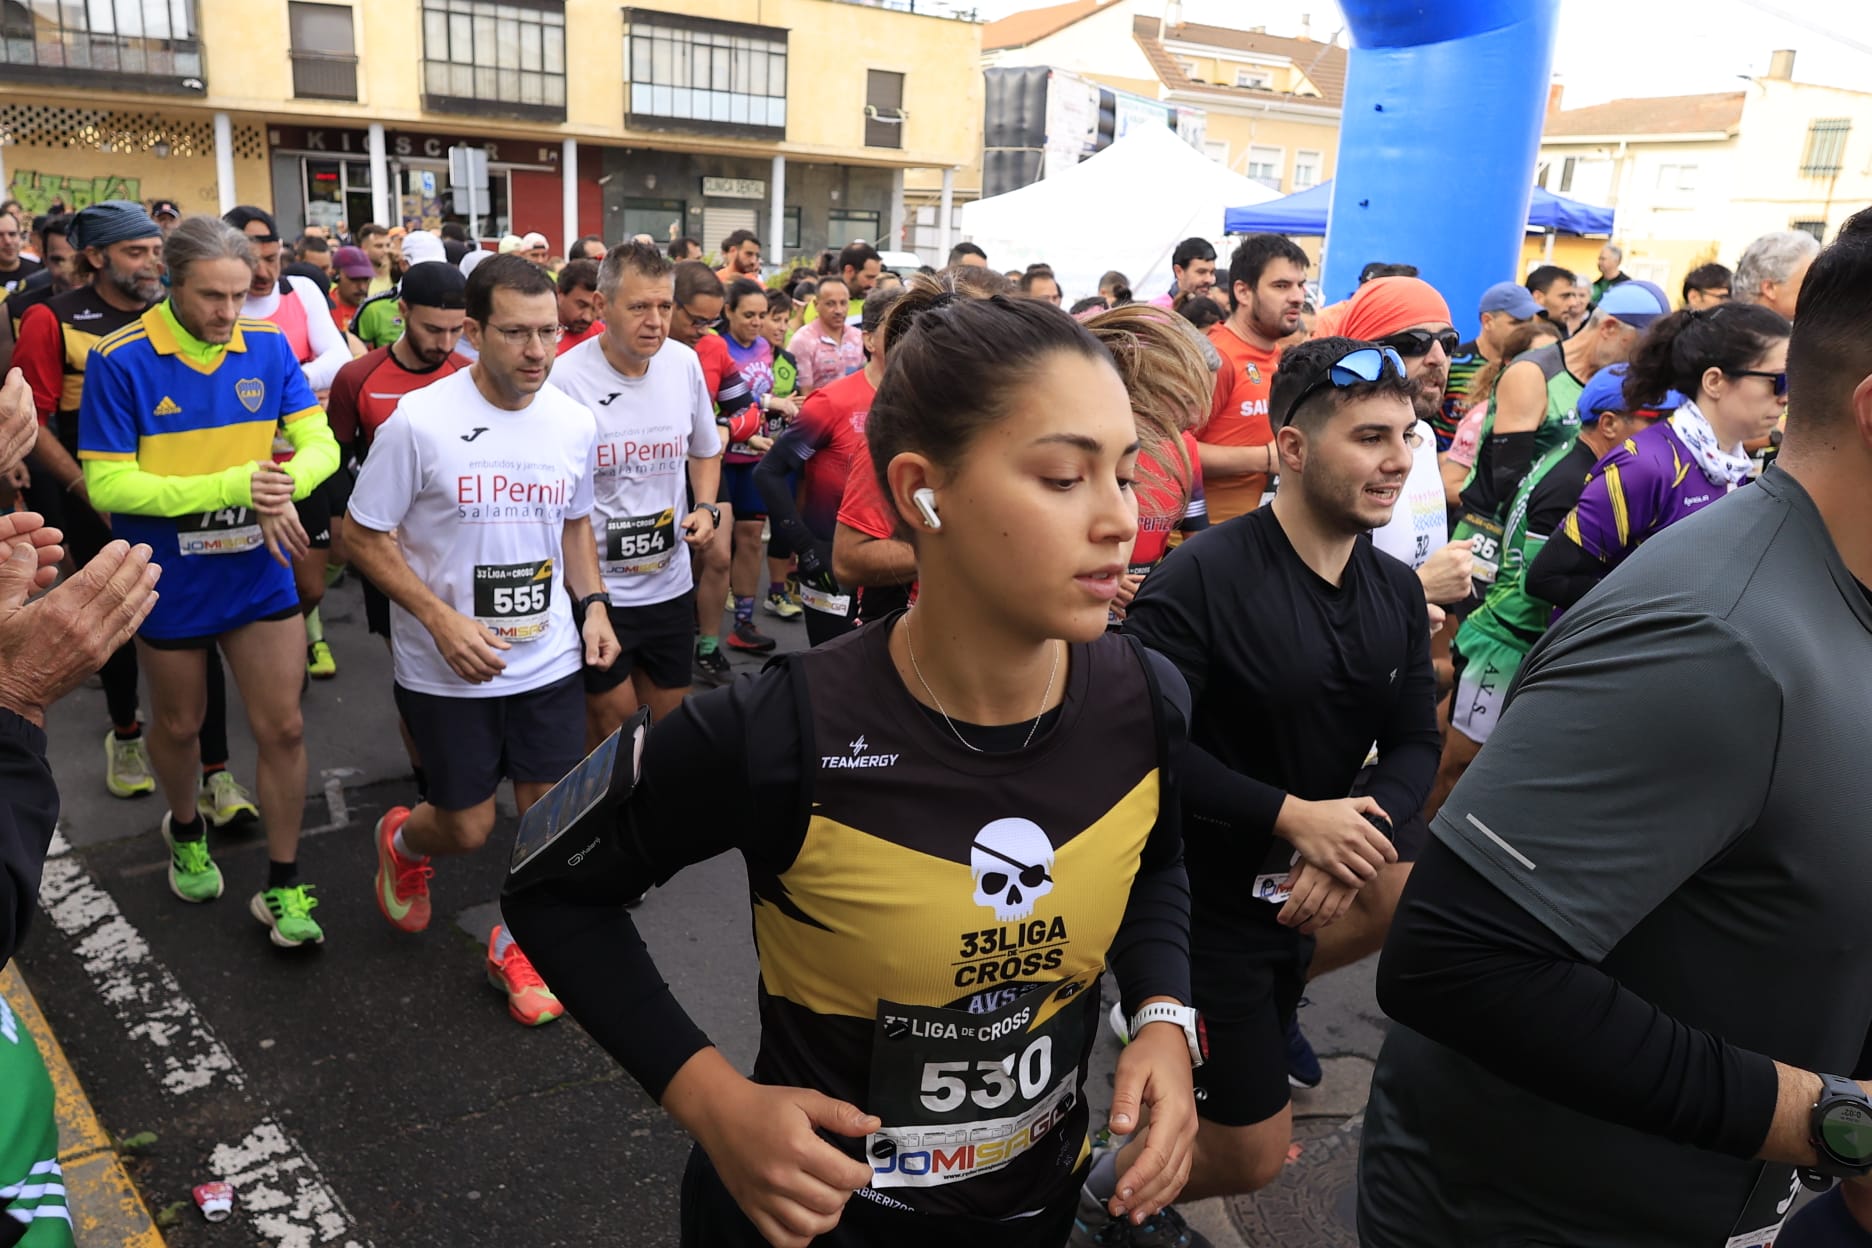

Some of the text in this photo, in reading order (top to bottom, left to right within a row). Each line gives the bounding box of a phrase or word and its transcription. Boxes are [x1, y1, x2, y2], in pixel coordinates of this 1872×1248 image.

[597, 435, 683, 467] El Pernil
[457, 474, 565, 505] El Pernil
[621, 530, 664, 557] 554
[488, 567, 506, 579] LIGA
[493, 583, 545, 614] 555
[821, 754, 899, 769] TEAMERGY
[954, 948, 1064, 988] CROSS
[968, 986, 1017, 1014] AVS
[911, 1018, 958, 1040] LIGA
[961, 1027, 975, 1037] DE
[977, 1006, 1030, 1042] CROSS
[920, 1035, 1052, 1113] 530
